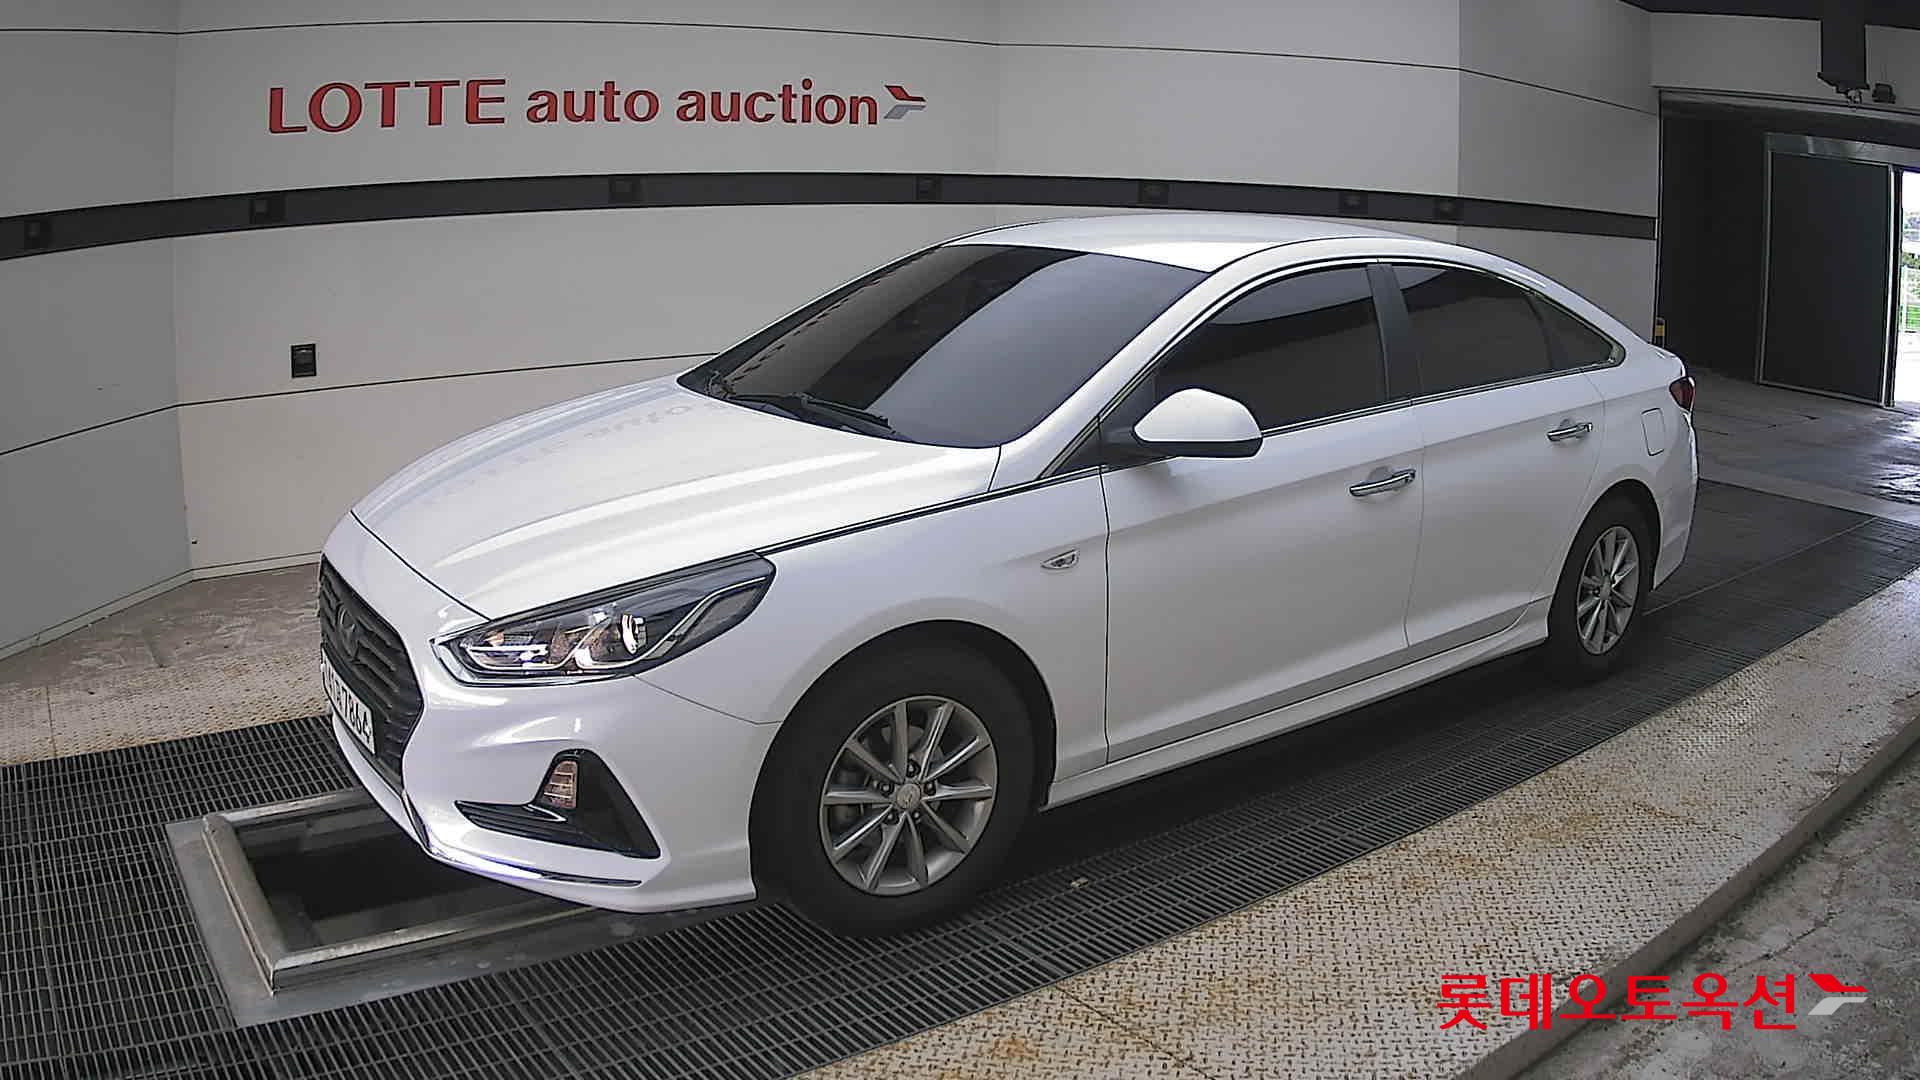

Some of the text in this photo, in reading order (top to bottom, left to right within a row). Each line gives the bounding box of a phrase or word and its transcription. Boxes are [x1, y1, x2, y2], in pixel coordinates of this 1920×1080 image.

[268, 78, 880, 133] LOTTE auto auction
